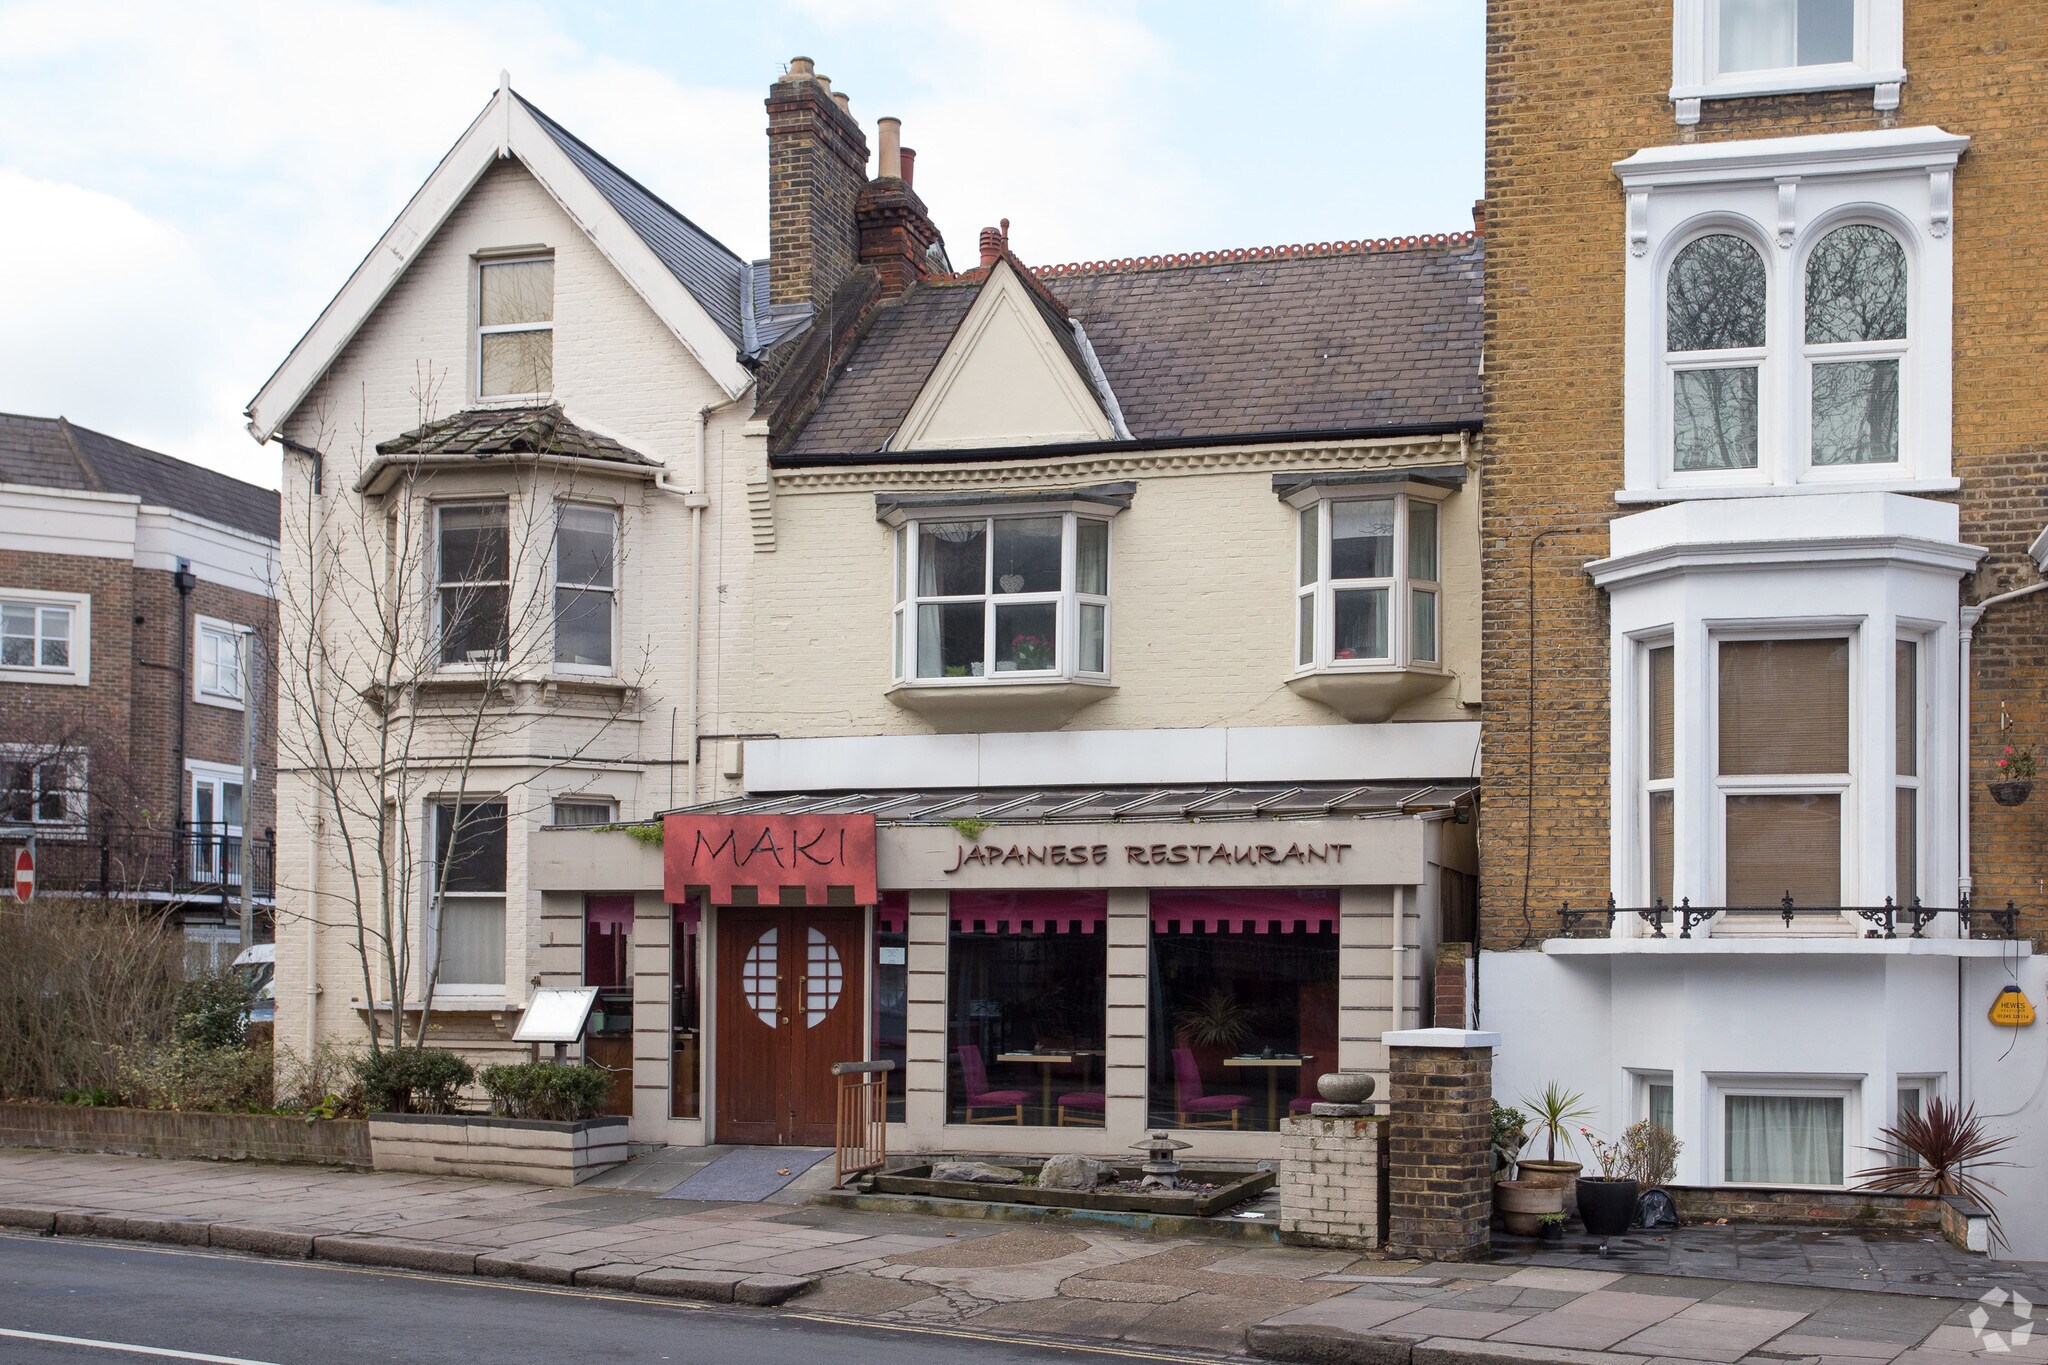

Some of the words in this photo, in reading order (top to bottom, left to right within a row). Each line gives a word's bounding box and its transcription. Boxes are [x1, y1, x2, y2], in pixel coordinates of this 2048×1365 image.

[691, 826, 846, 869] MAKI
[943, 843, 1109, 874] JAPANESE
[1124, 842, 1352, 866] RESTAURANT
